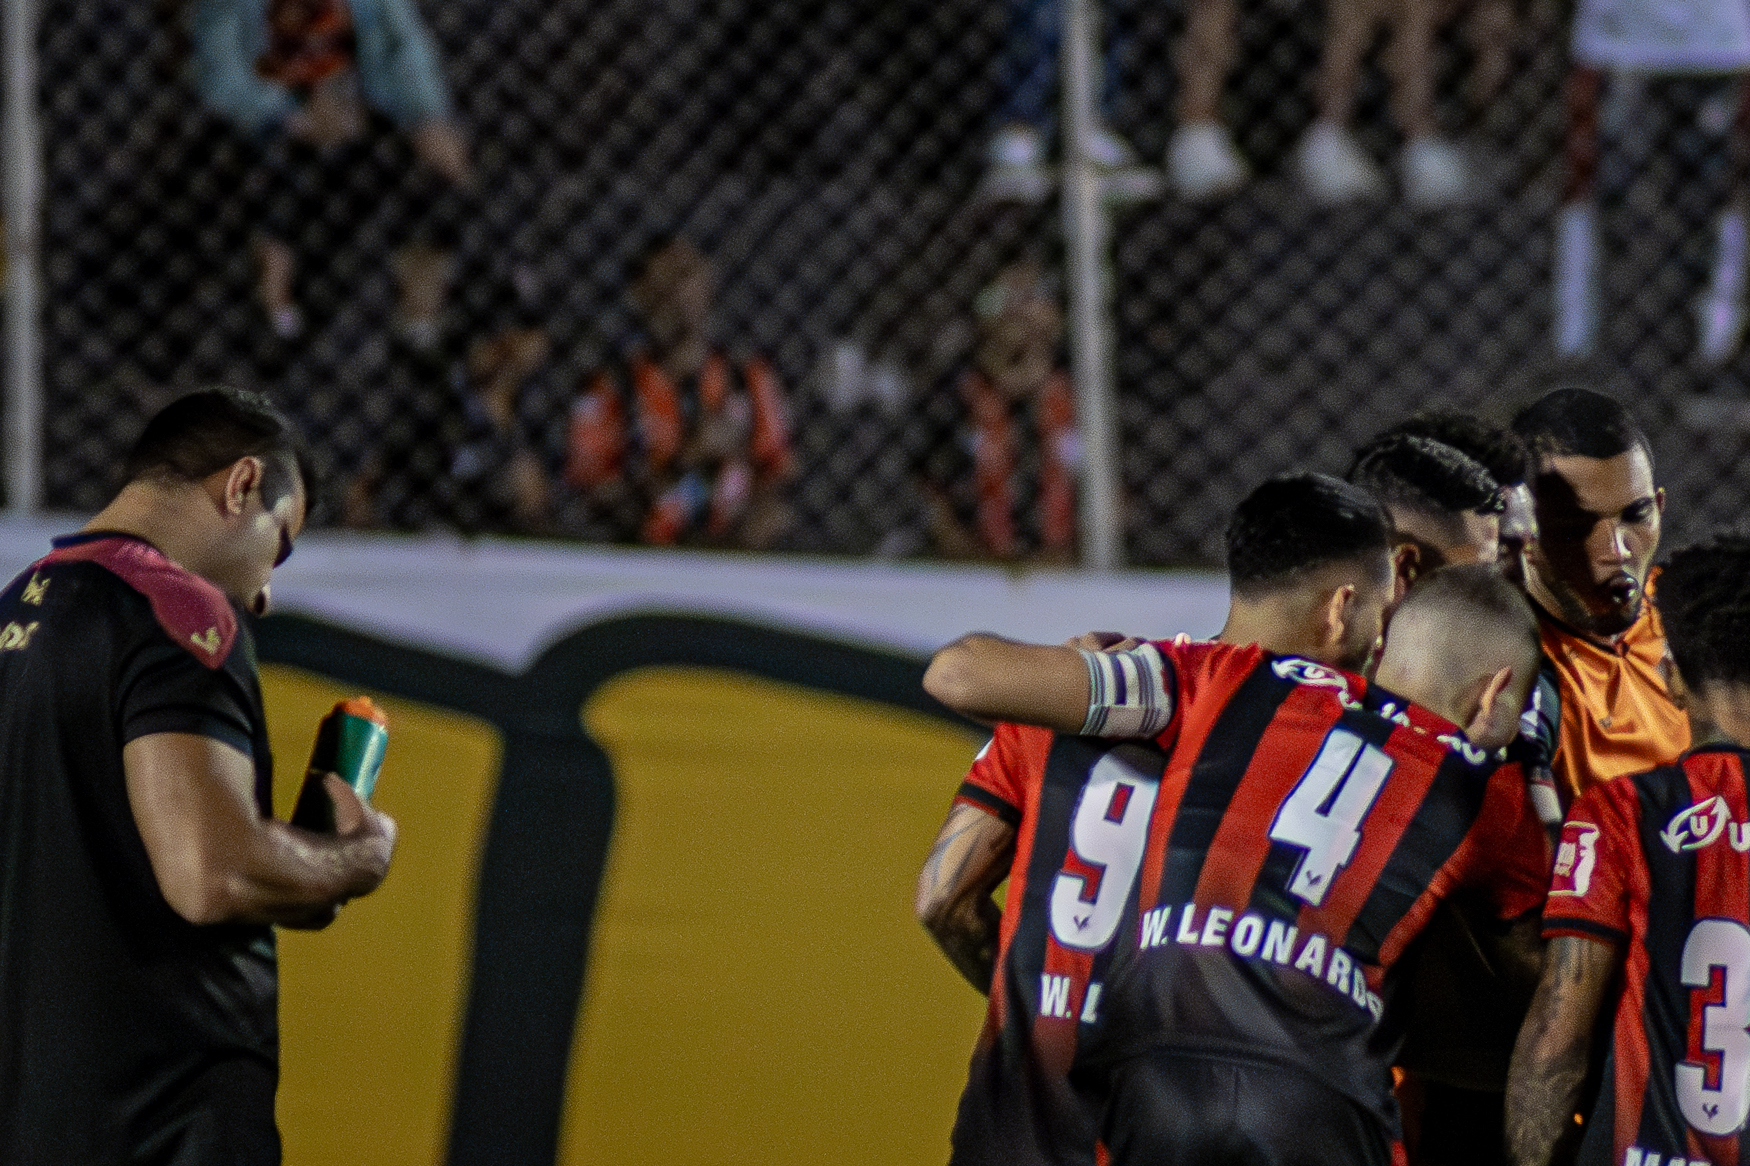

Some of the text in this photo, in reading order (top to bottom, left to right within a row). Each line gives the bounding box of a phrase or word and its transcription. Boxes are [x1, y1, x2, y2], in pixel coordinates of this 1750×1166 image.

[1049, 748, 1160, 951] 9
[1269, 724, 1396, 907] 4
[1139, 905, 1171, 950] W.
[1040, 973, 1072, 1020] W.
